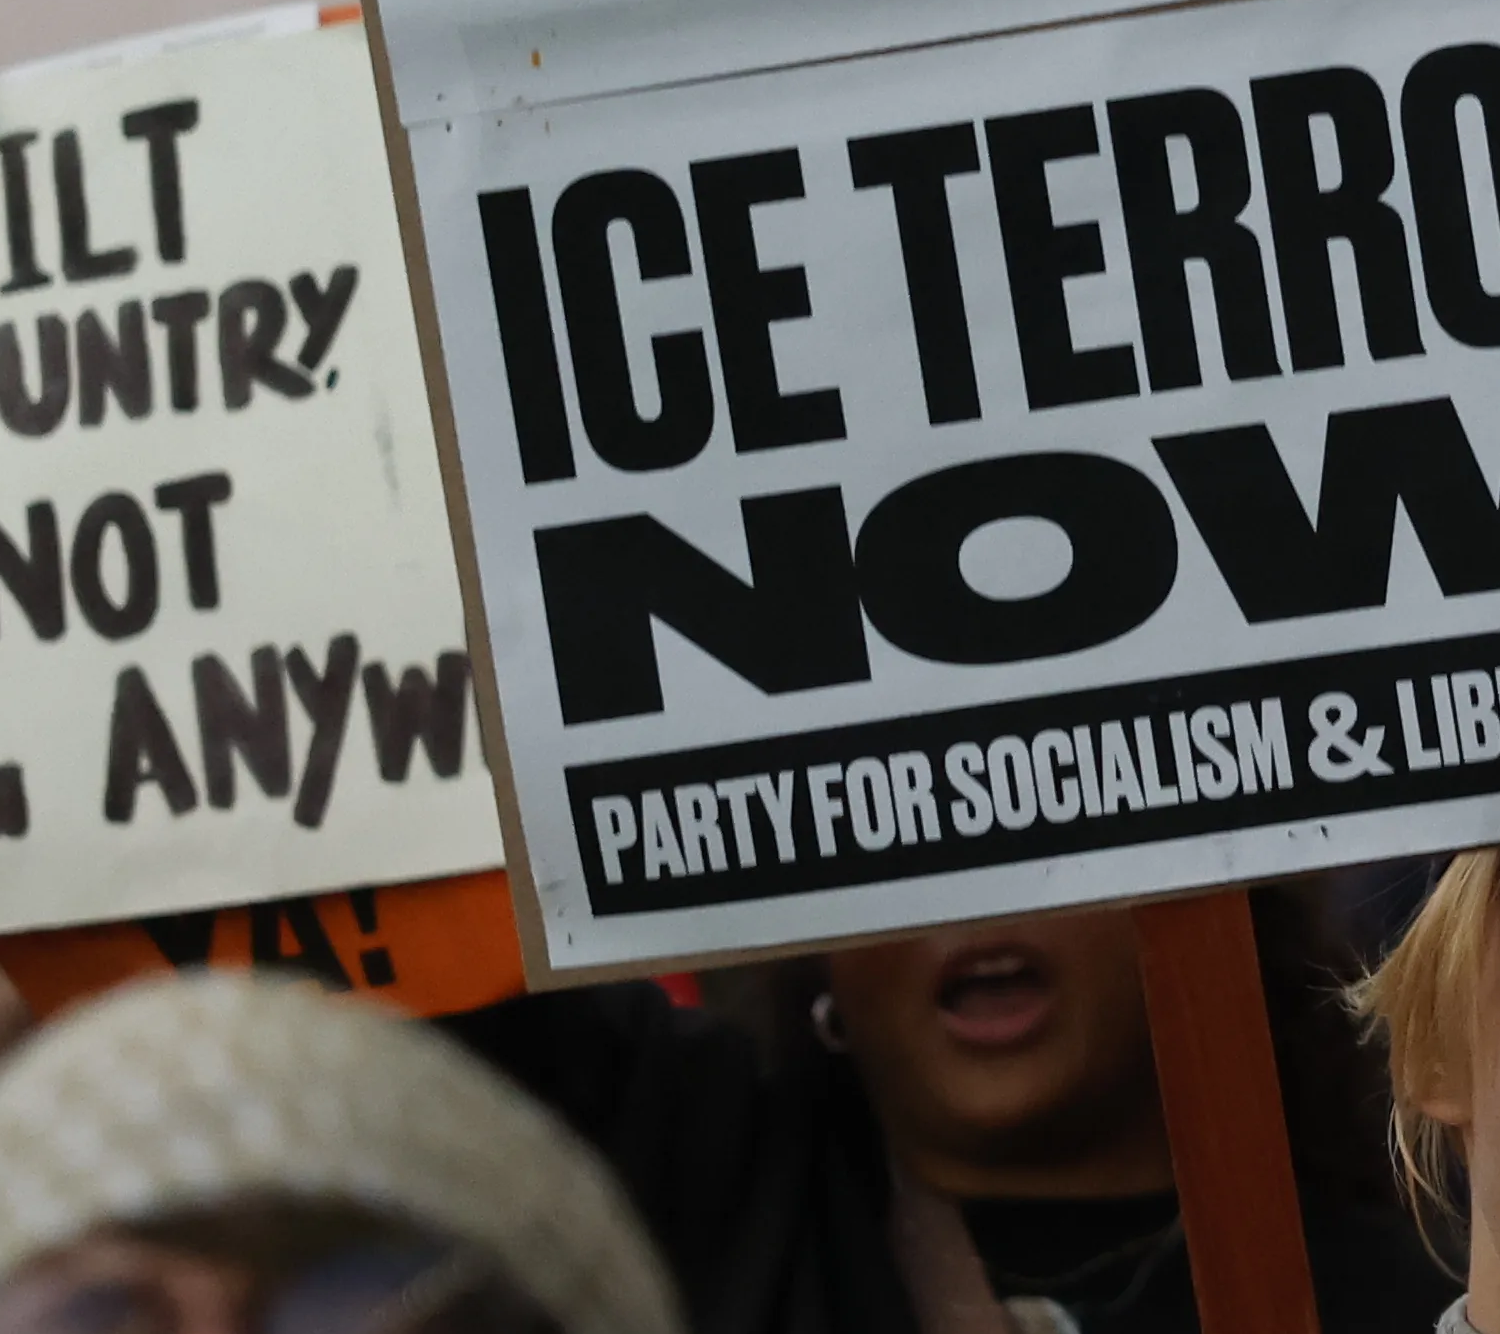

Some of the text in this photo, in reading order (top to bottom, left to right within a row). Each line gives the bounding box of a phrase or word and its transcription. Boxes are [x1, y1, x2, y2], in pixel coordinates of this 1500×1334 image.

[477, 147, 848, 484] ICE
[591, 768, 797, 886] PARTY
[806, 749, 942, 858] FOR
[943, 695, 1296, 838] SOCIALISM
[1307, 689, 1395, 785] &
